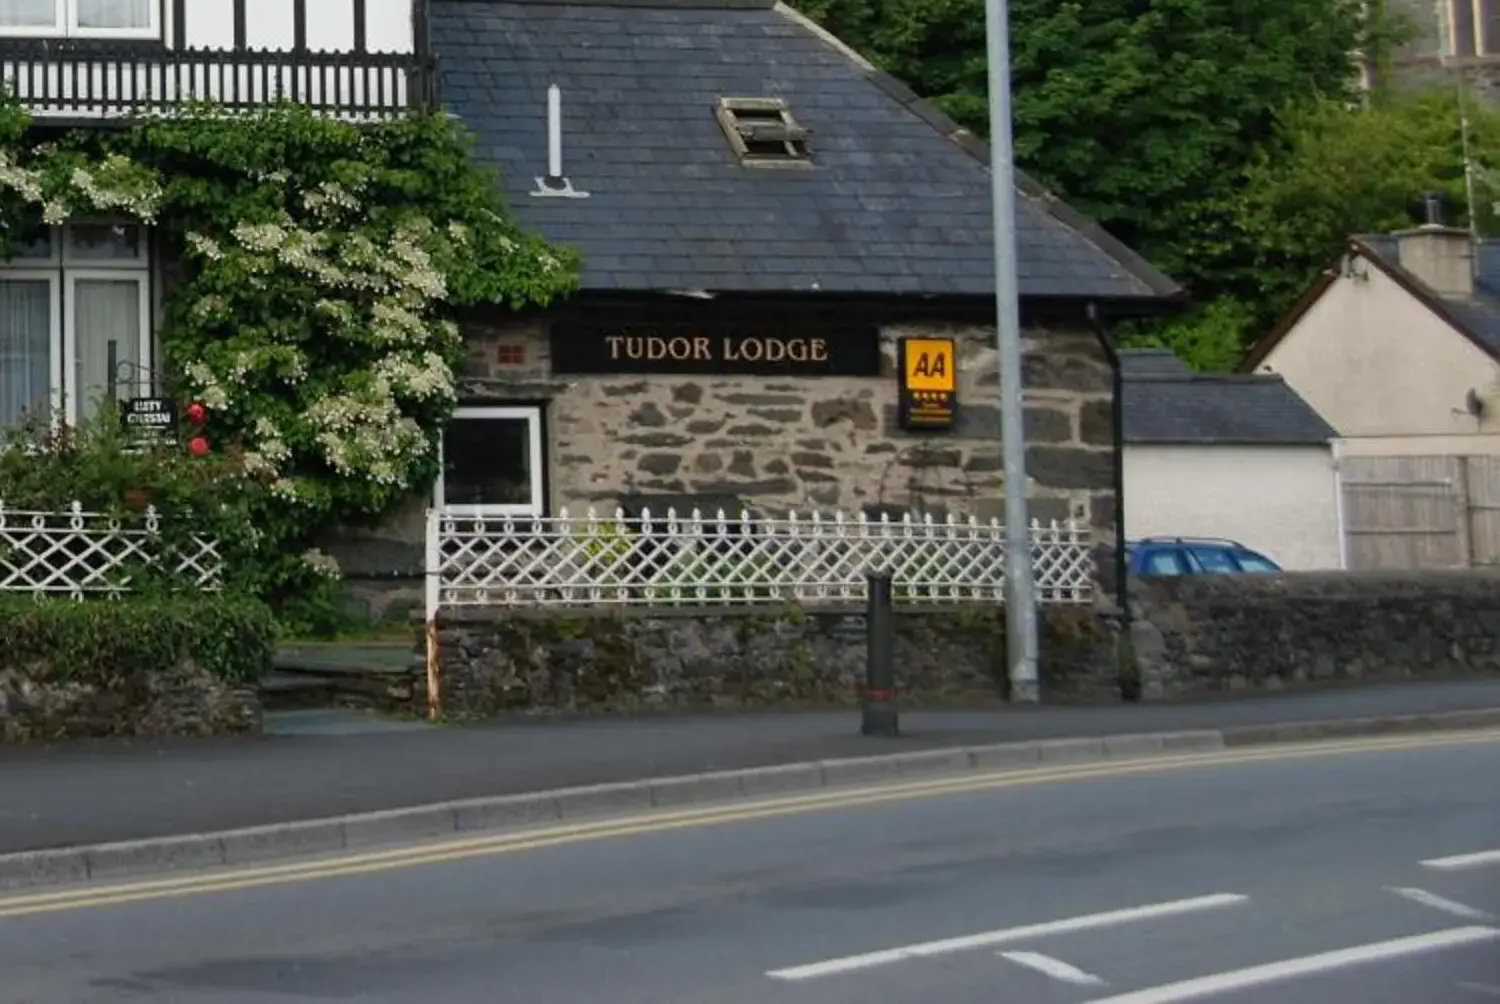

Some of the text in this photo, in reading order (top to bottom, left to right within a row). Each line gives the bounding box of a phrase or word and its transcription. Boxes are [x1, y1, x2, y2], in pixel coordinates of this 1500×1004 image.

[605, 336, 828, 362] TUDOR LODGE
[912, 352, 946, 378] AA
